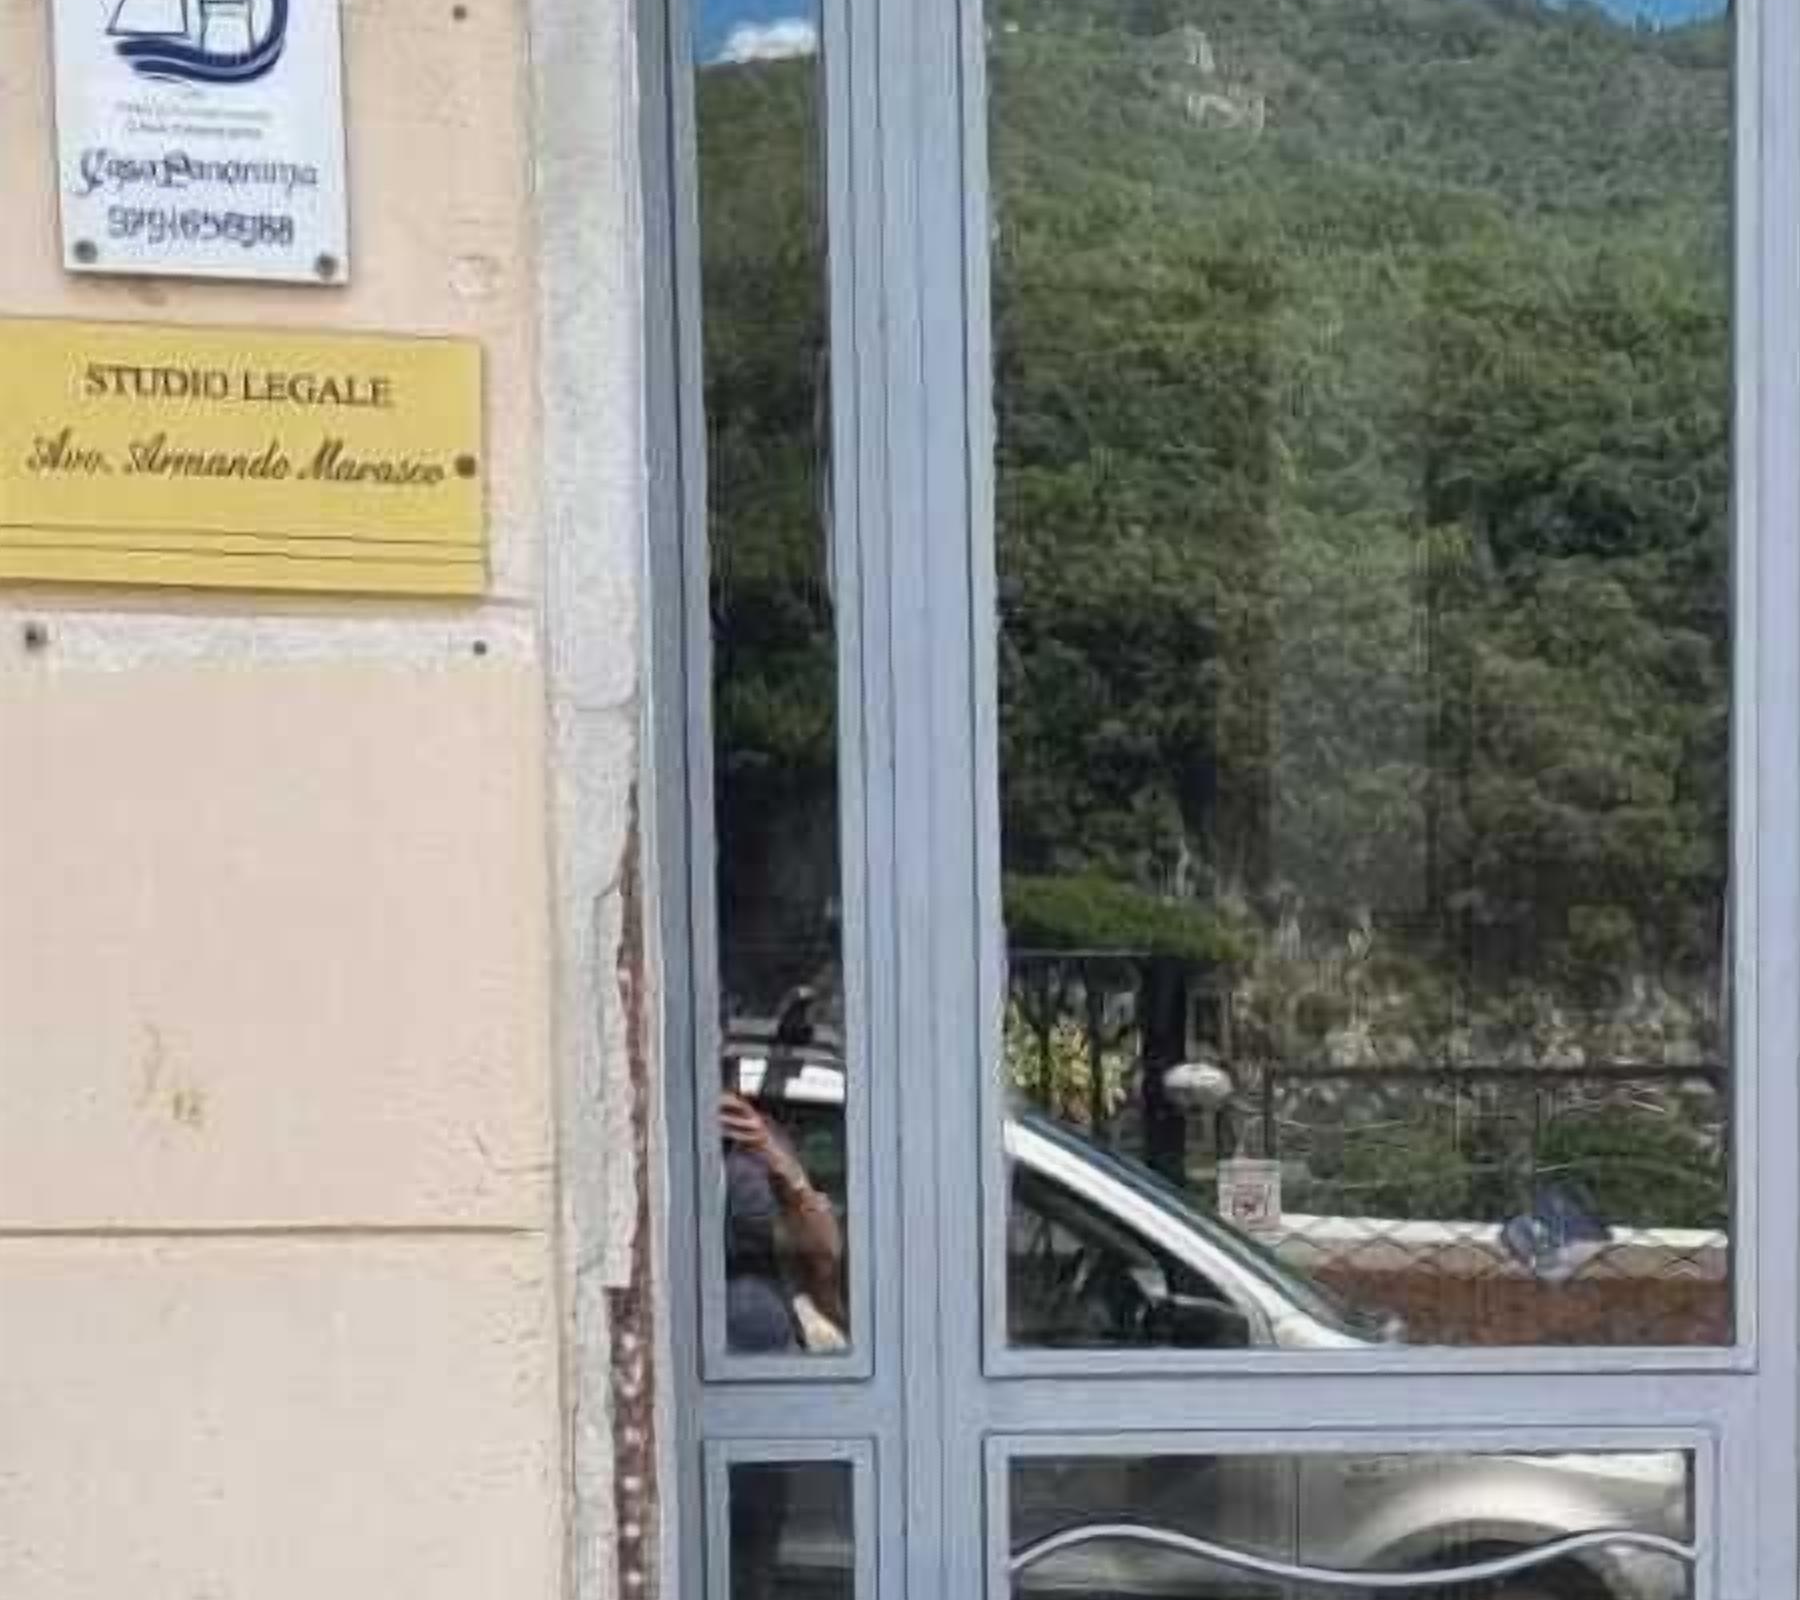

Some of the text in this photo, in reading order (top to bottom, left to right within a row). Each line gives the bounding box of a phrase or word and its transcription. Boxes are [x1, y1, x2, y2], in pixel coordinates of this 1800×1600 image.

[85, 362, 398, 408] STUDIO LEGALE
[123, 431, 291, 480] Armando
[297, 436, 446, 485] Marasco
